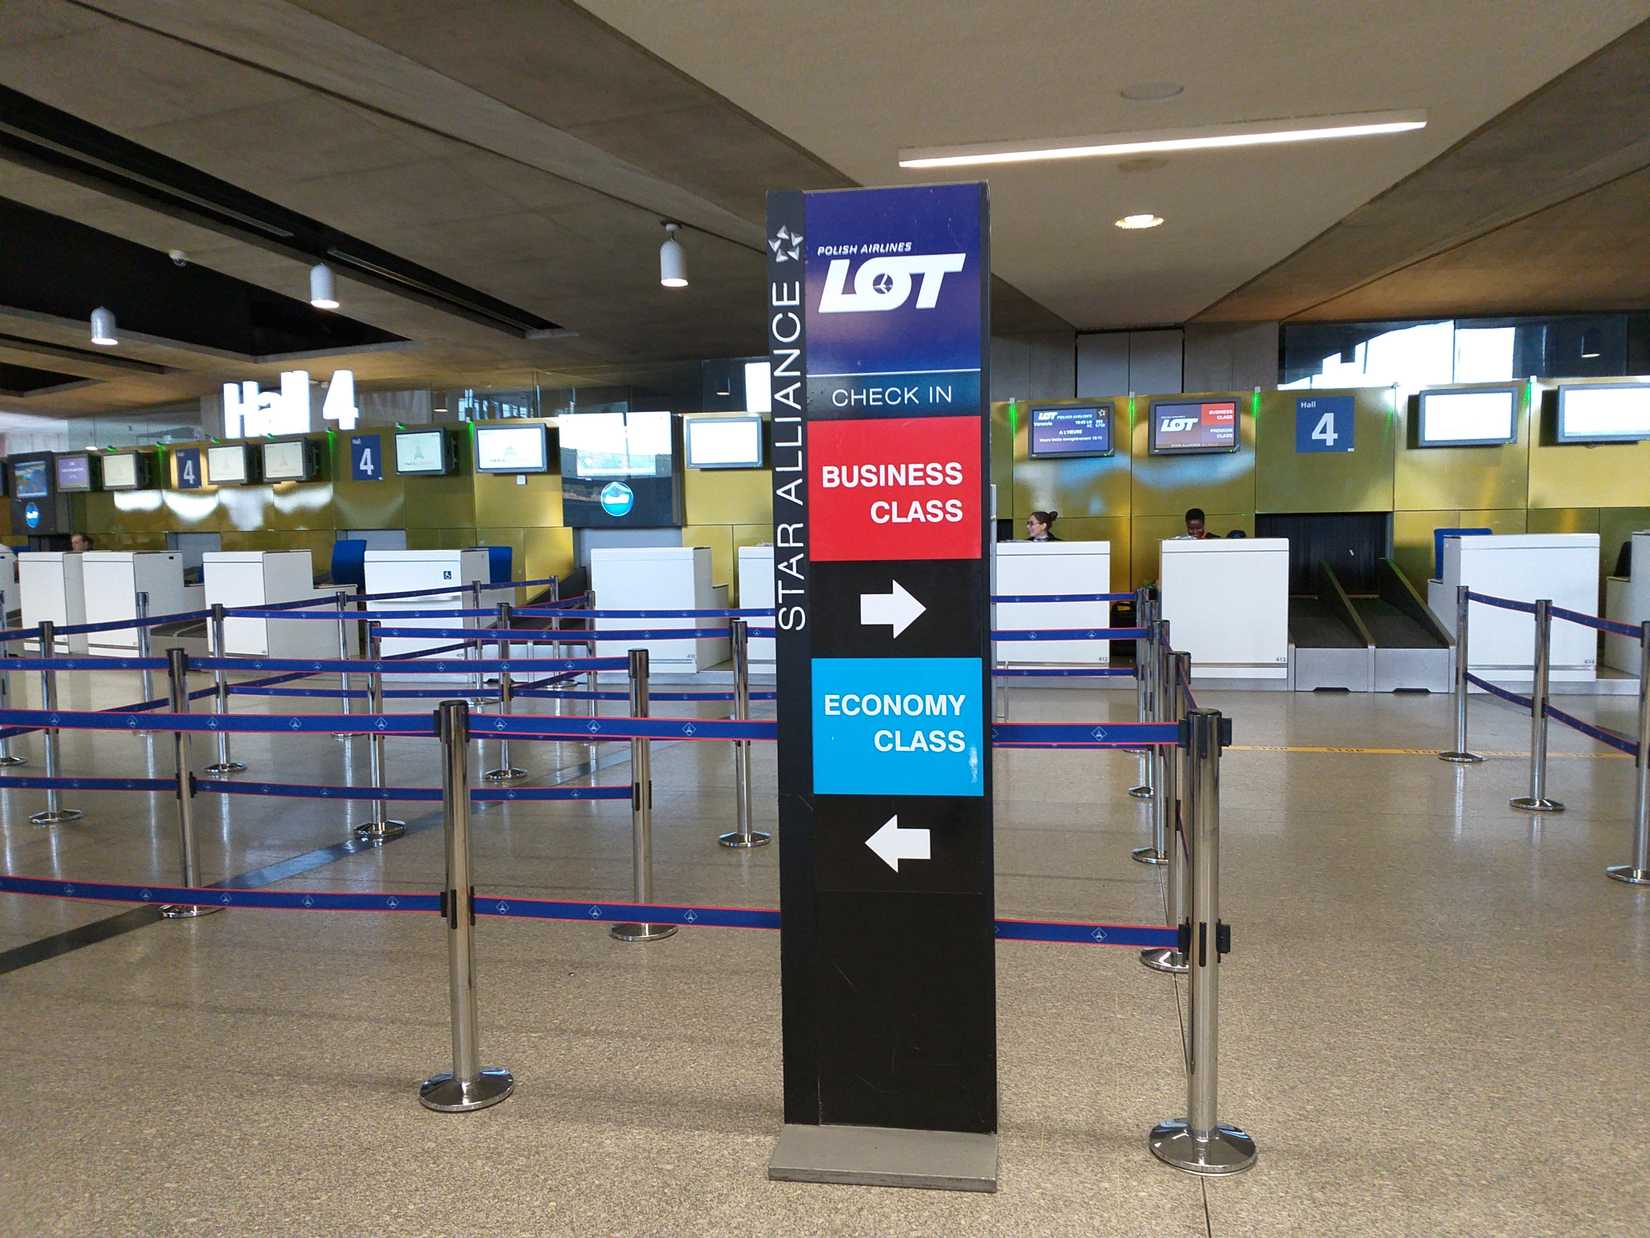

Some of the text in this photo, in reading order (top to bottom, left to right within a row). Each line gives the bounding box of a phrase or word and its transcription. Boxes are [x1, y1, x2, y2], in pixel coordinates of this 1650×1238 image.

[817, 242, 912, 256] POLISH AIRLINES
[818, 253, 966, 313] LOT
[223, 369, 359, 439] Hall 4
[832, 385, 952, 407] CHECK IN
[1160, 418, 1199, 432] LOT
[1311, 412, 1338, 446] 4
[360, 447, 374, 475] 4
[772, 281, 806, 631] STAR ALLIANCE
[183, 460, 195, 484] 4
[822, 461, 963, 488] BUSINESS
[870, 499, 963, 523] CLASS
[824, 694, 966, 716] ECONOMY
[874, 730, 966, 752] CLASS
